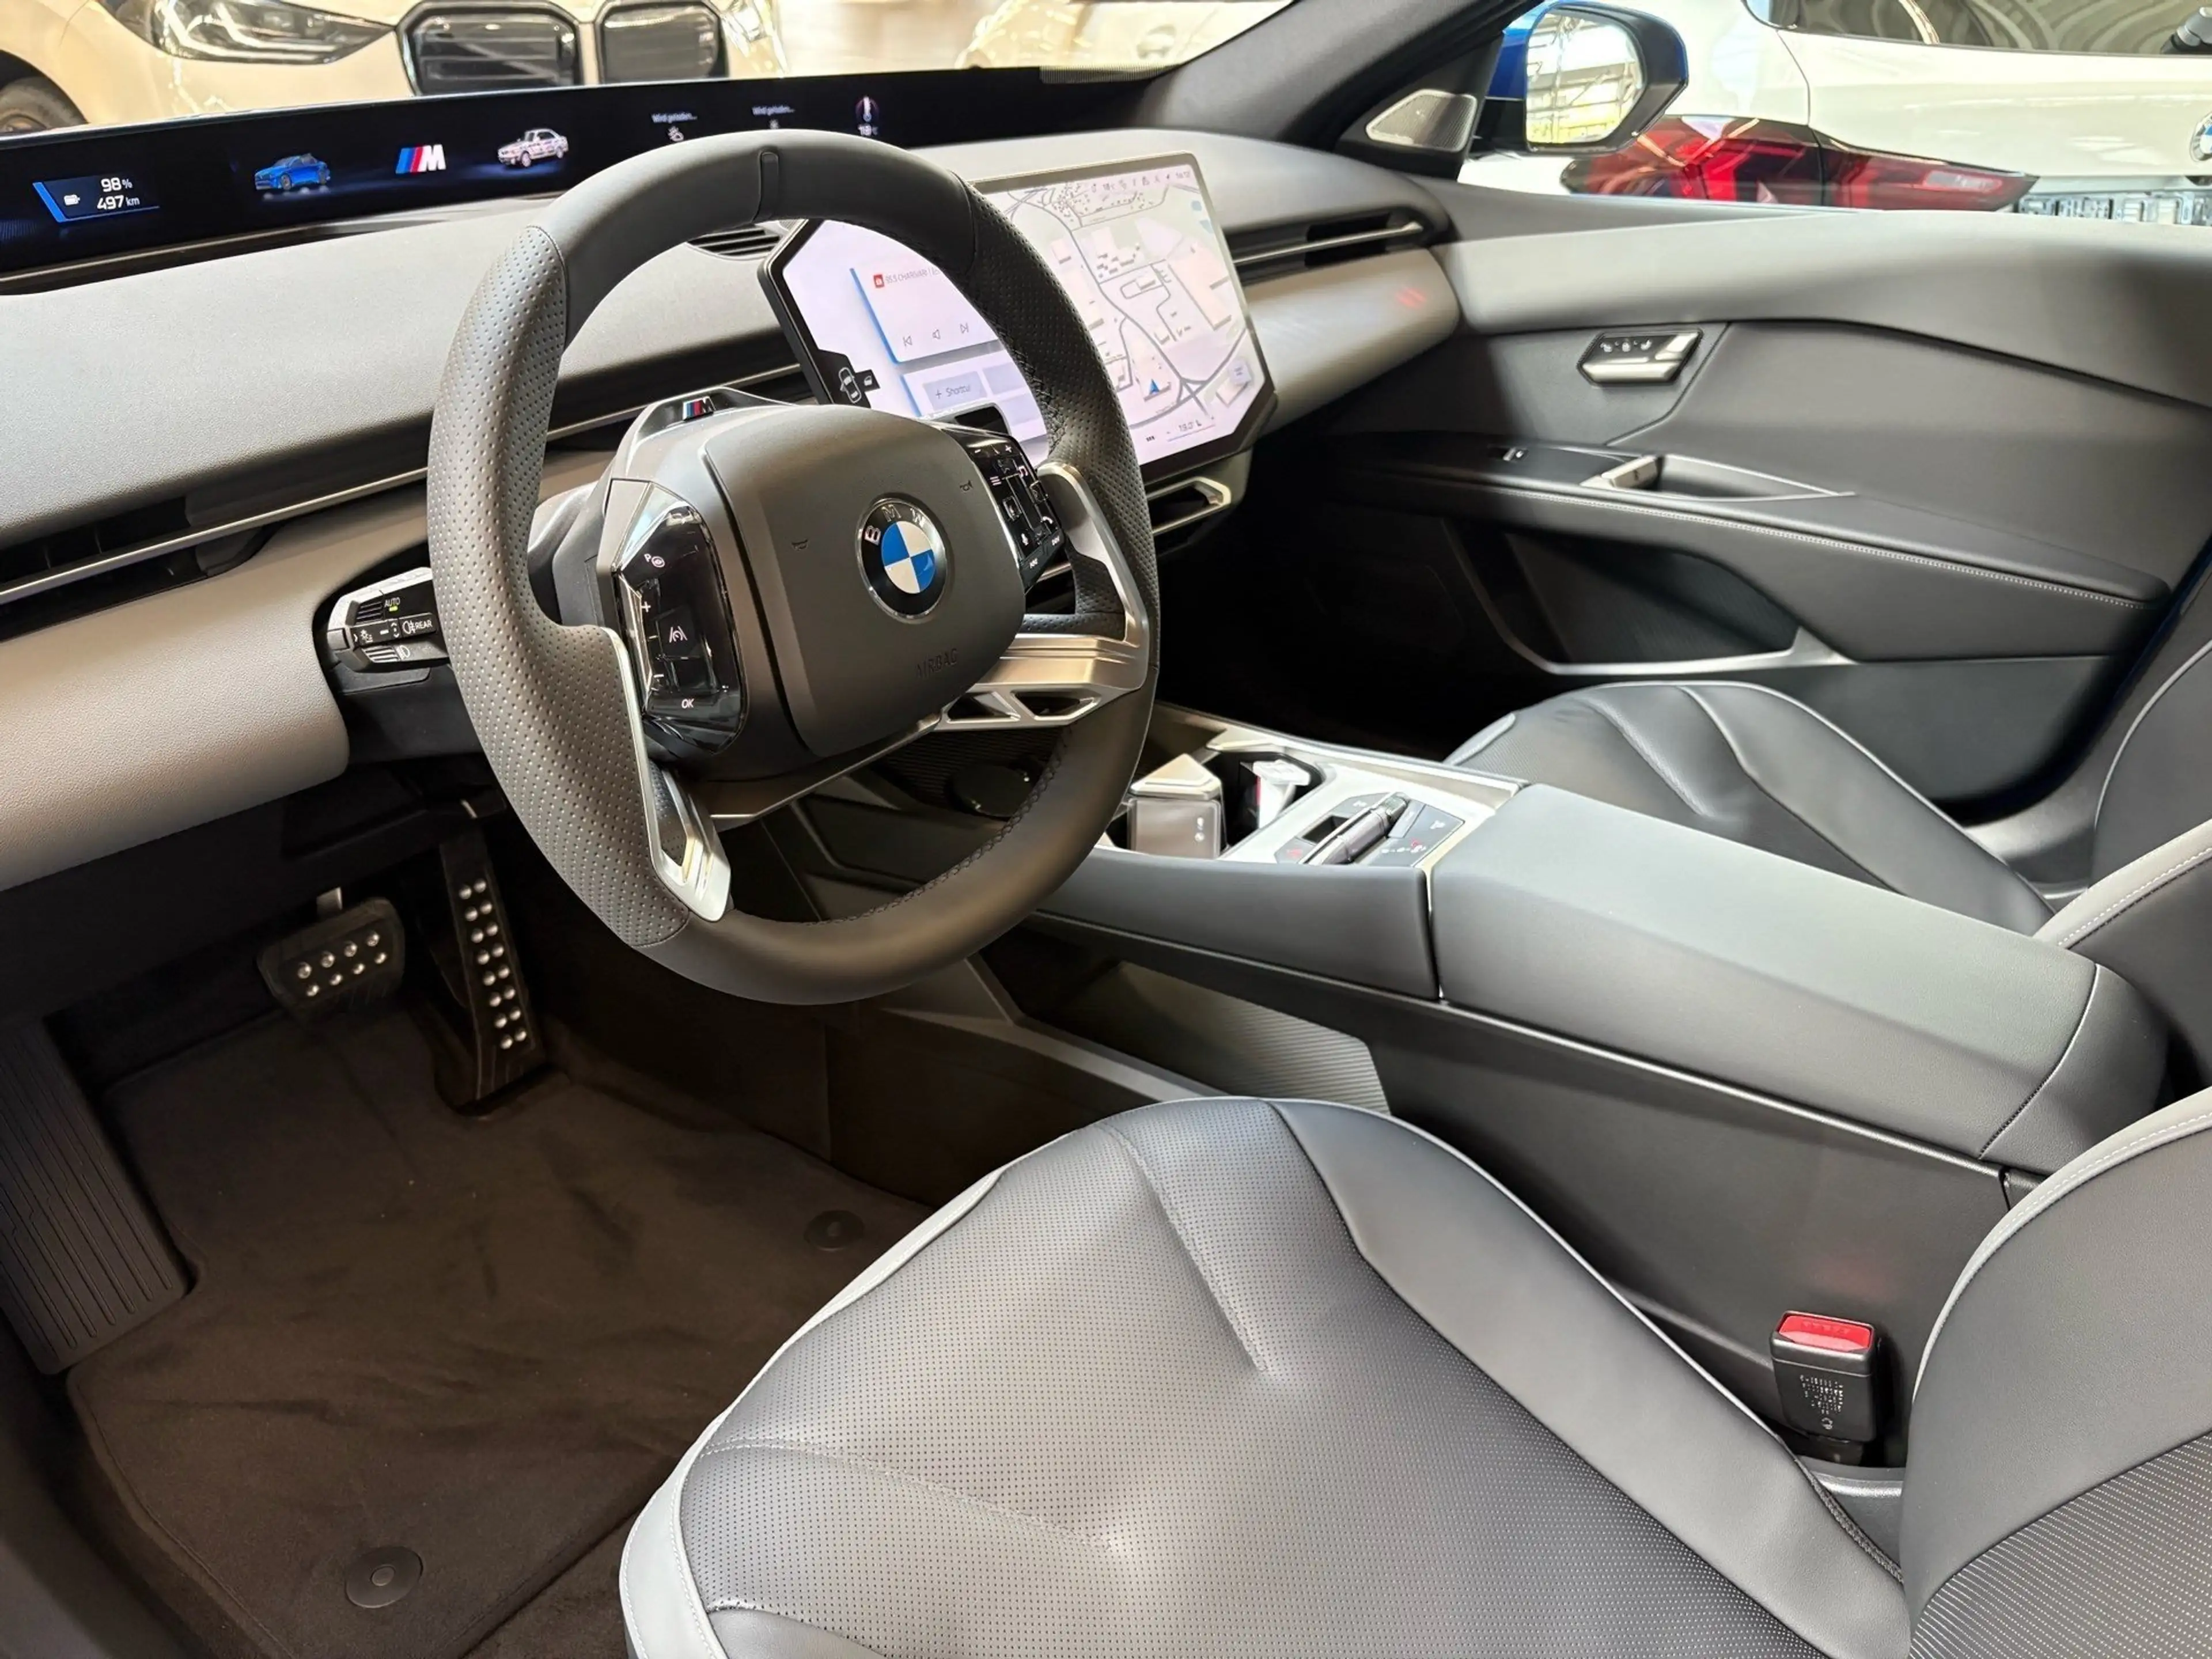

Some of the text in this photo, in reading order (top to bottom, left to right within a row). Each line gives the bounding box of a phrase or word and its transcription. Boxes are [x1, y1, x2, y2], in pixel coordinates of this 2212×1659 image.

[417, 144, 446, 172] M
[96, 194, 140, 210] 497 km
[865, 504, 926, 546] BMW
[384, 597, 401, 608] AUTO
[415, 619, 433, 630] REAR
[914, 647, 957, 678] AIRBAG
[681, 698, 695, 709] OK
